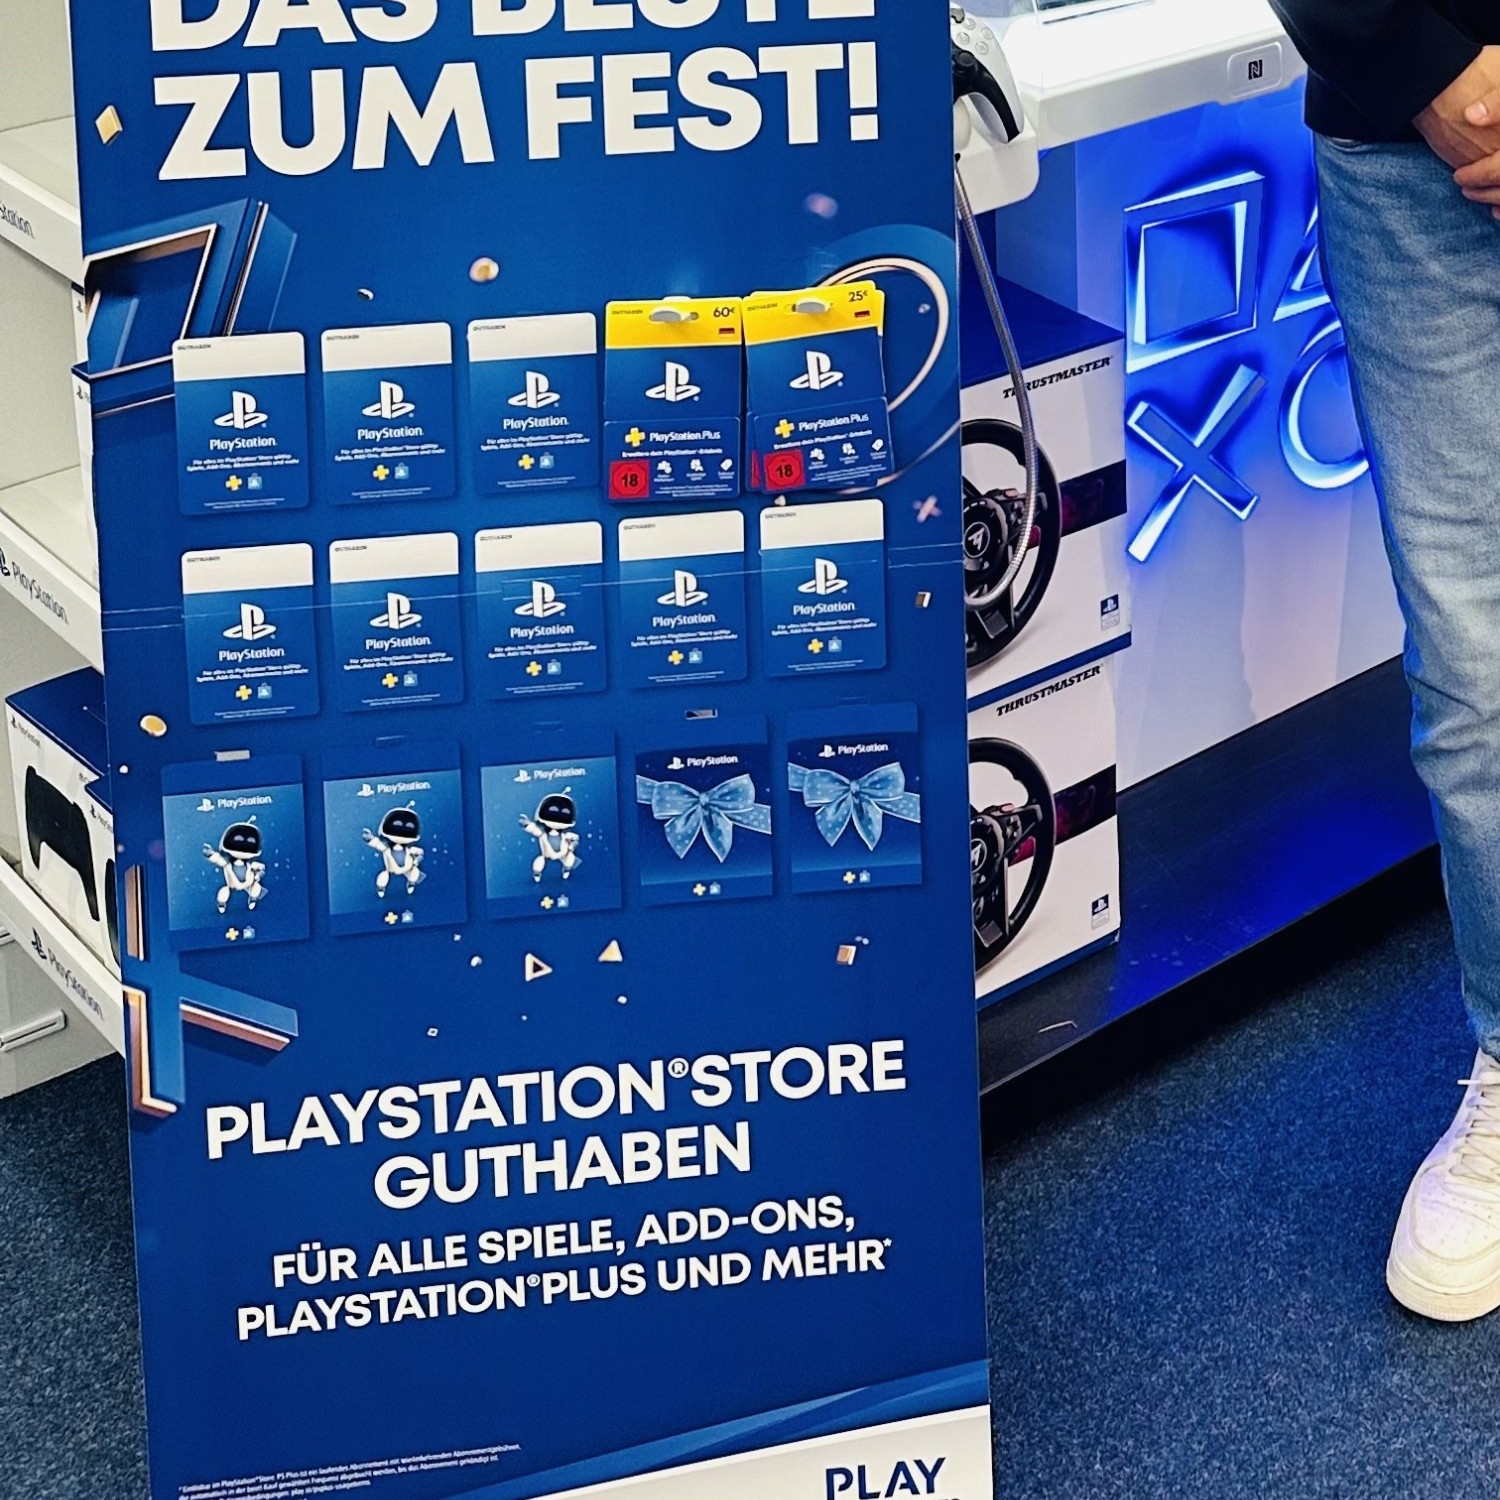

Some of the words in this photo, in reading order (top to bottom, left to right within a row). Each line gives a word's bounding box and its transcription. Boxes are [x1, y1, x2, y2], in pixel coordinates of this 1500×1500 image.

[153, 62, 497, 180] ZUM
[527, 41, 880, 160] FEST!
[713, 305, 736, 318] 60€
[1002, 355, 1112, 400] TRUSTMASTER
[503, 415, 568, 431] PlayStation
[850, 413, 870, 422] Plus
[357, 426, 423, 442] PlayStation
[649, 431, 701, 444] PlayStation
[702, 430, 721, 440] Plus
[209, 436, 276, 452] PlayStation
[775, 464, 793, 478] 18
[621, 473, 638, 487] 18
[12, 562, 69, 625] PlayStation
[793, 601, 855, 617] PlayStation
[652, 613, 715, 629] PlayStation
[510, 624, 574, 640] PlayStation
[365, 636, 431, 651] PlayStation
[218, 647, 285, 662] PlayStation
[996, 665, 1101, 717] THRUSTMASTER
[838, 743, 889, 756] PlayStation
[687, 755, 738, 768] PlayStation
[533, 767, 586, 780] PlayStation
[377, 780, 431, 795] PlayStation
[217, 795, 272, 810] PlayStation
[46, 946, 106, 1023] PlayStation
[690, 1039, 907, 1107] STORE
[373, 1121, 752, 1210] GUTHABEN
[272, 1240, 359, 1288] FÜR
[368, 1232, 467, 1278] ALLE
[478, 1217, 626, 1266] SPIELE,
[635, 1194, 855, 1249] ADD-ONS,
[541, 1262, 646, 1304] PLUS
[657, 1251, 752, 1293] UND
[825, 1457, 946, 1500] PLAY
